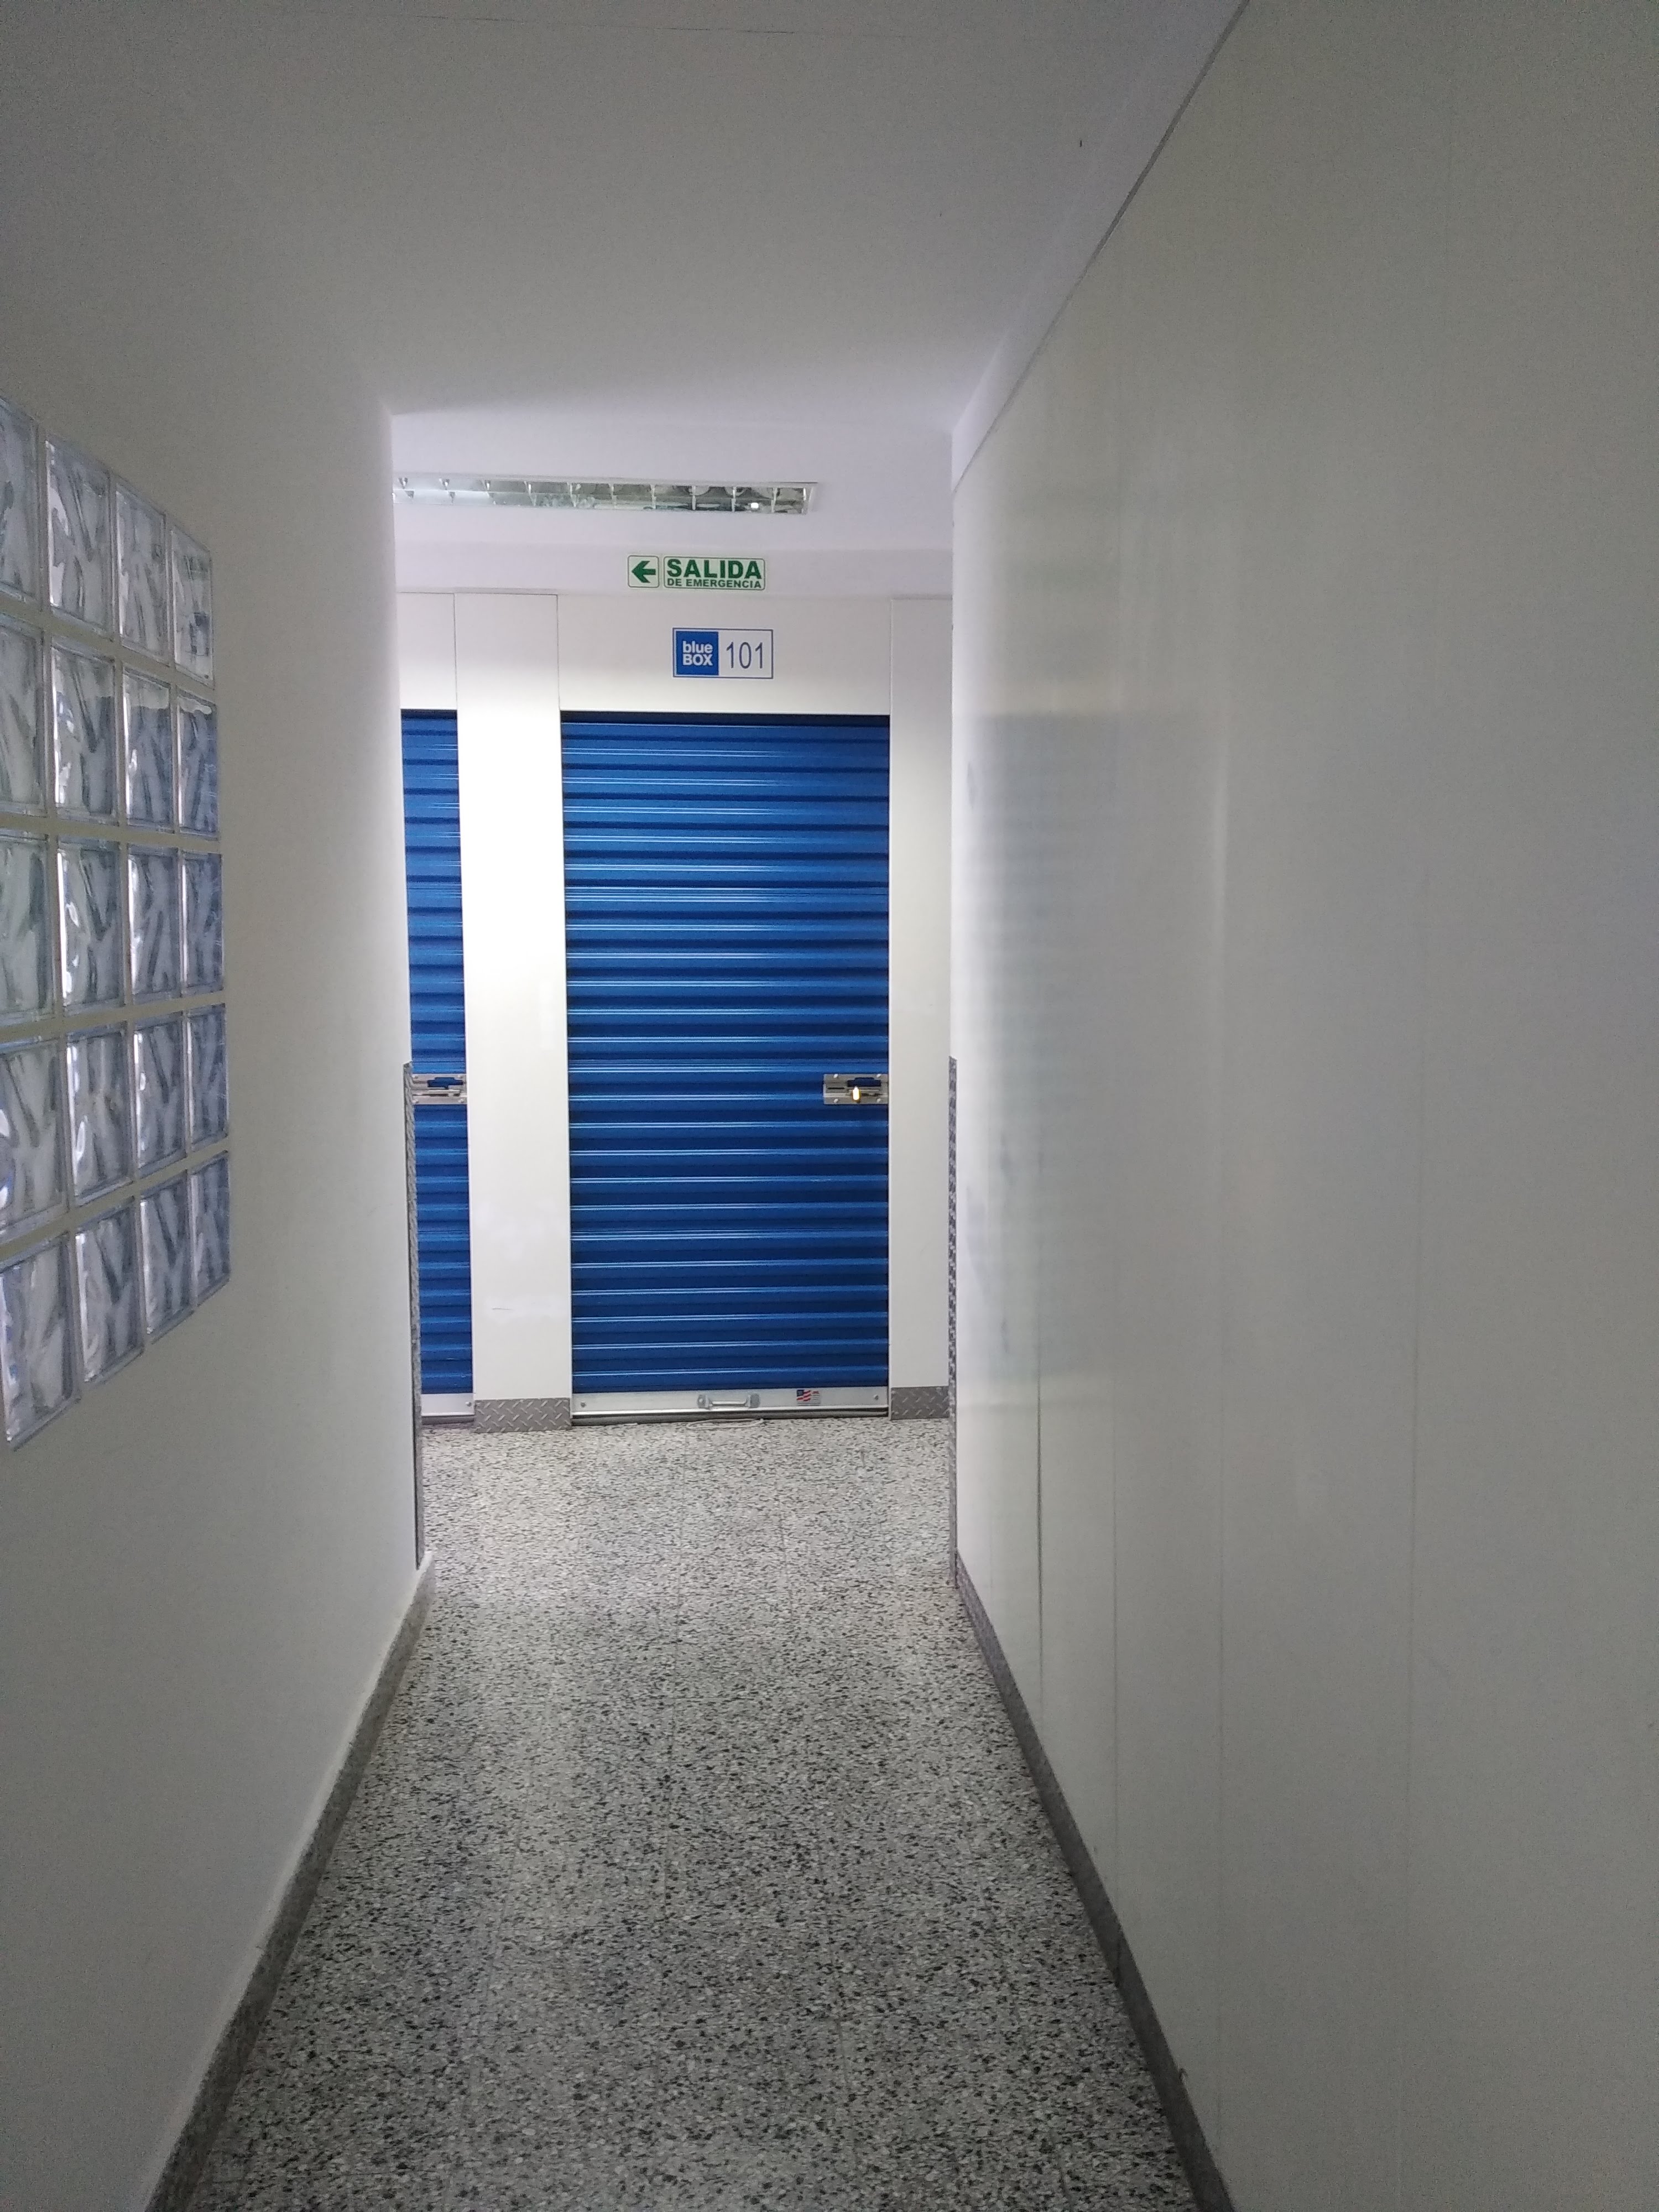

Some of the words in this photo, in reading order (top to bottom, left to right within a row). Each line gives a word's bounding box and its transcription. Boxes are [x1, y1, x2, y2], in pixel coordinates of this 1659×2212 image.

[666, 559, 762, 580] SALIDA
[667, 578, 682, 587] DE
[686, 578, 762, 588] EMERGENCIA
[682, 640, 713, 654] blue
[682, 654, 713, 666] BOX
[726, 641, 763, 669] 101
